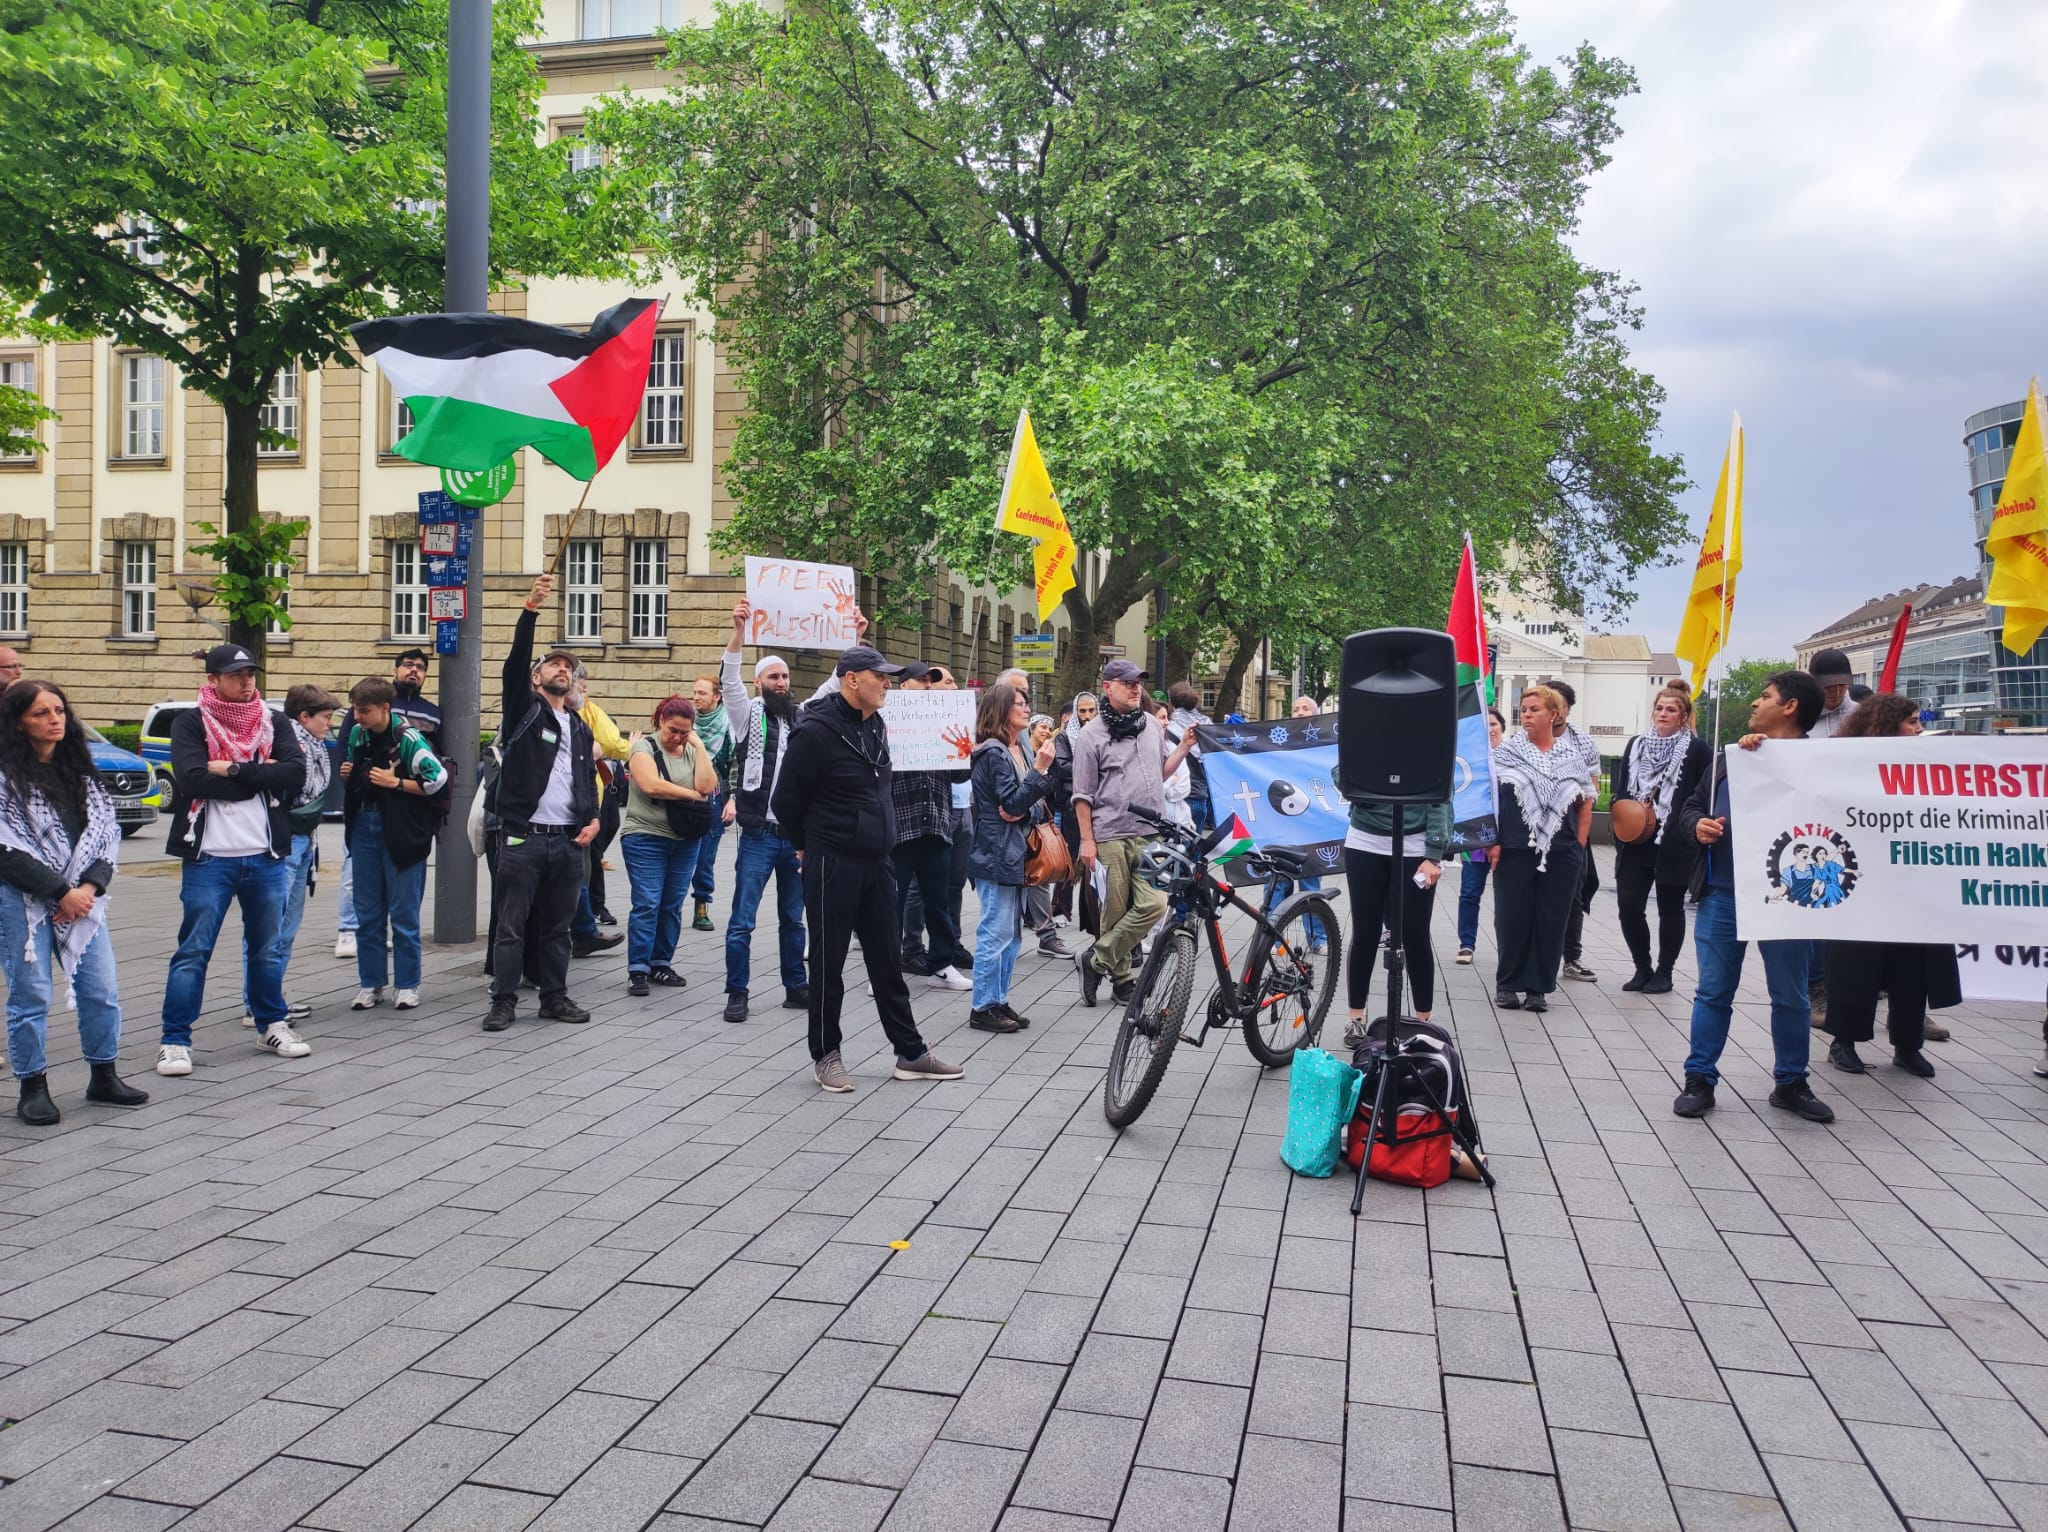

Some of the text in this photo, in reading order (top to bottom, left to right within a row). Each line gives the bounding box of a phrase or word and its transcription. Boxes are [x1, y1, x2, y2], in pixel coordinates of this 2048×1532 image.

[1015, 507, 1055, 529] Confederation
[757, 563, 833, 590] FREE
[886, 692, 945, 707] olidarität
[1878, 763, 2048, 797] WIDERST
[1846, 806, 1914, 833] Stoppt
[1920, 808, 1950, 829] die
[1890, 840, 2048, 868] Filistin Halk
